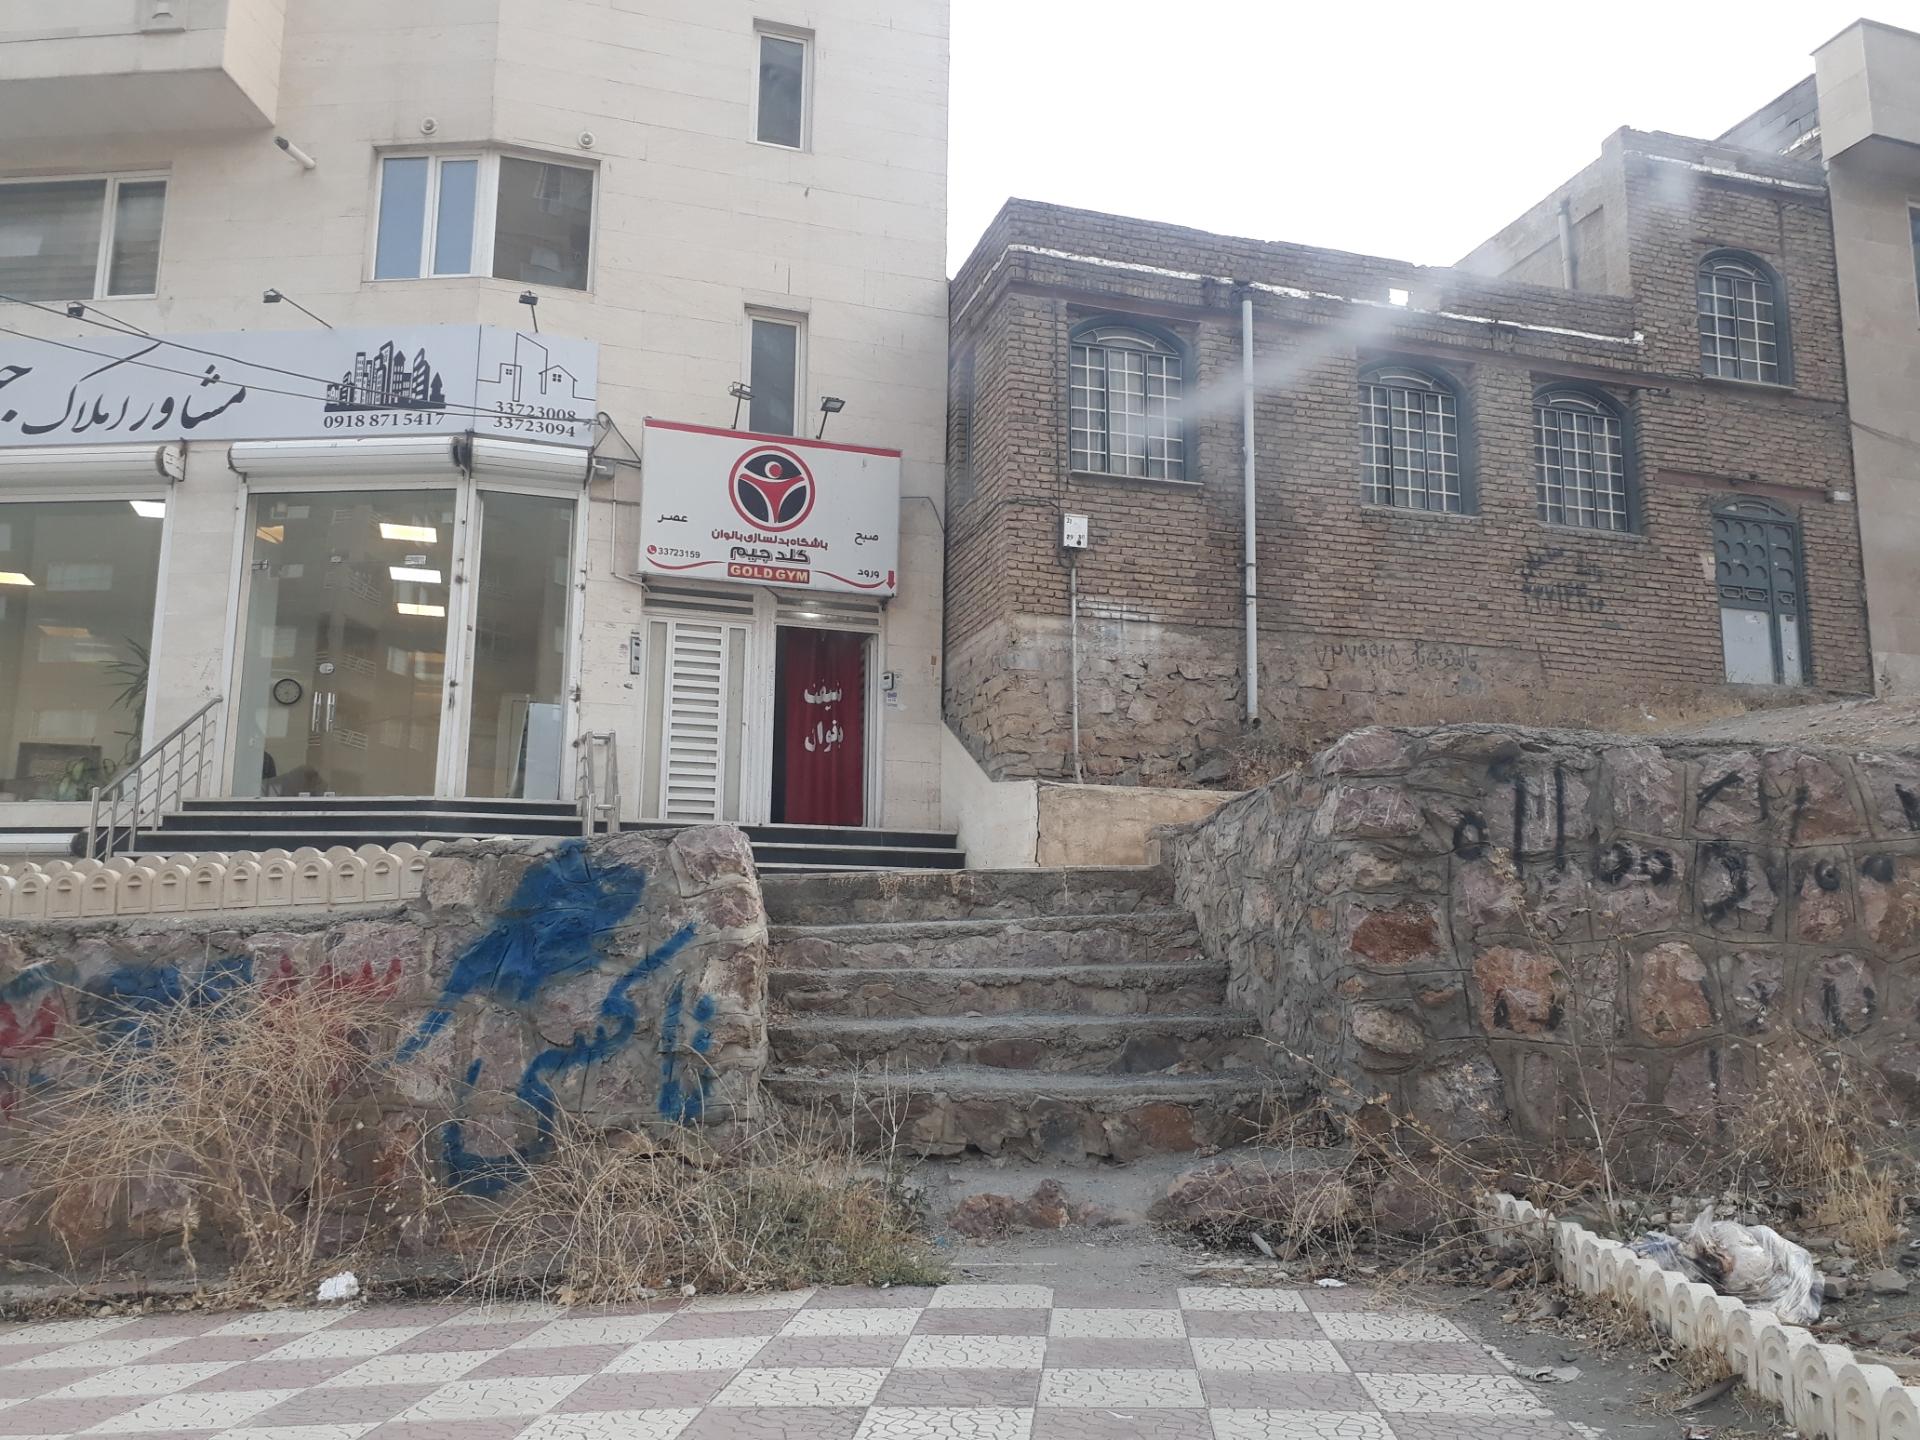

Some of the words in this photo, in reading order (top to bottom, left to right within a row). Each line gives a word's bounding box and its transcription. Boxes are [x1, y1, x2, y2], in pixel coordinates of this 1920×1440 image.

[20, 341, 163, 436] املاک
[128, 363, 248, 432] مشاور
[495, 400, 577, 421] 33723008
[323, 412, 366, 430] 0918
[368, 412, 399, 428] 871
[402, 410, 447, 427] 5417
[492, 416, 576, 438] 33723094
[656, 513, 689, 523] عصر
[711, 528, 743, 543] بانوان
[744, 532, 789, 547] بدنسازی
[790, 536, 829, 551] باشگاه
[854, 532, 879, 546] صبح
[657, 547, 701, 559] 33723159
[729, 546, 773, 563] جیم
[730, 564, 774, 579] GOLD
[775, 569, 809, 583] GYM
[857, 569, 880, 579] ورود
